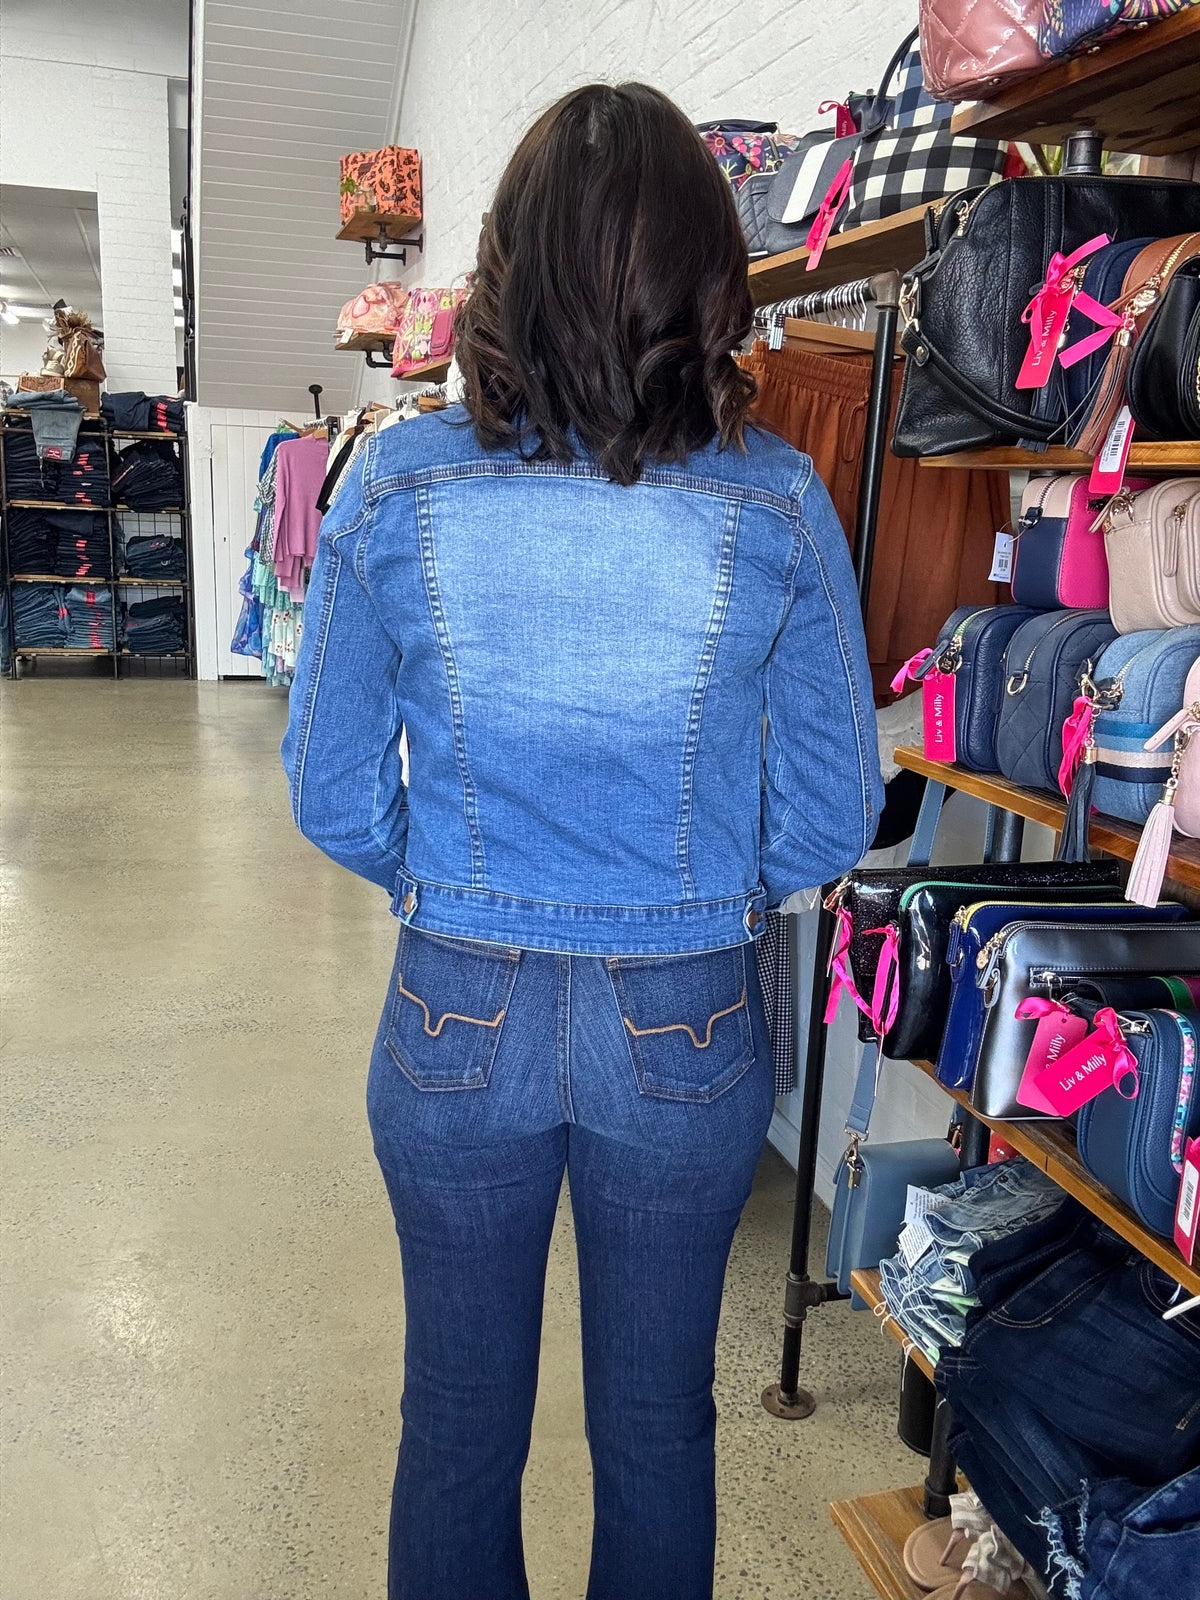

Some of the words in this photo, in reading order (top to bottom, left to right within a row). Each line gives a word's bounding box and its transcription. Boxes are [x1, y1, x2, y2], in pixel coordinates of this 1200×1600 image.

[1031, 350, 1043, 366] Liv
[1041, 310, 1058, 336] Milly
[933, 693, 944, 717] Milly
[934, 728, 943, 743] Liv
[935, 719, 943, 727] &
[1046, 1033, 1066, 1061] Milly
[1059, 1076, 1076, 1091] Liv
[1075, 1070, 1085, 1081] &
[1081, 1053, 1107, 1075] Milly
